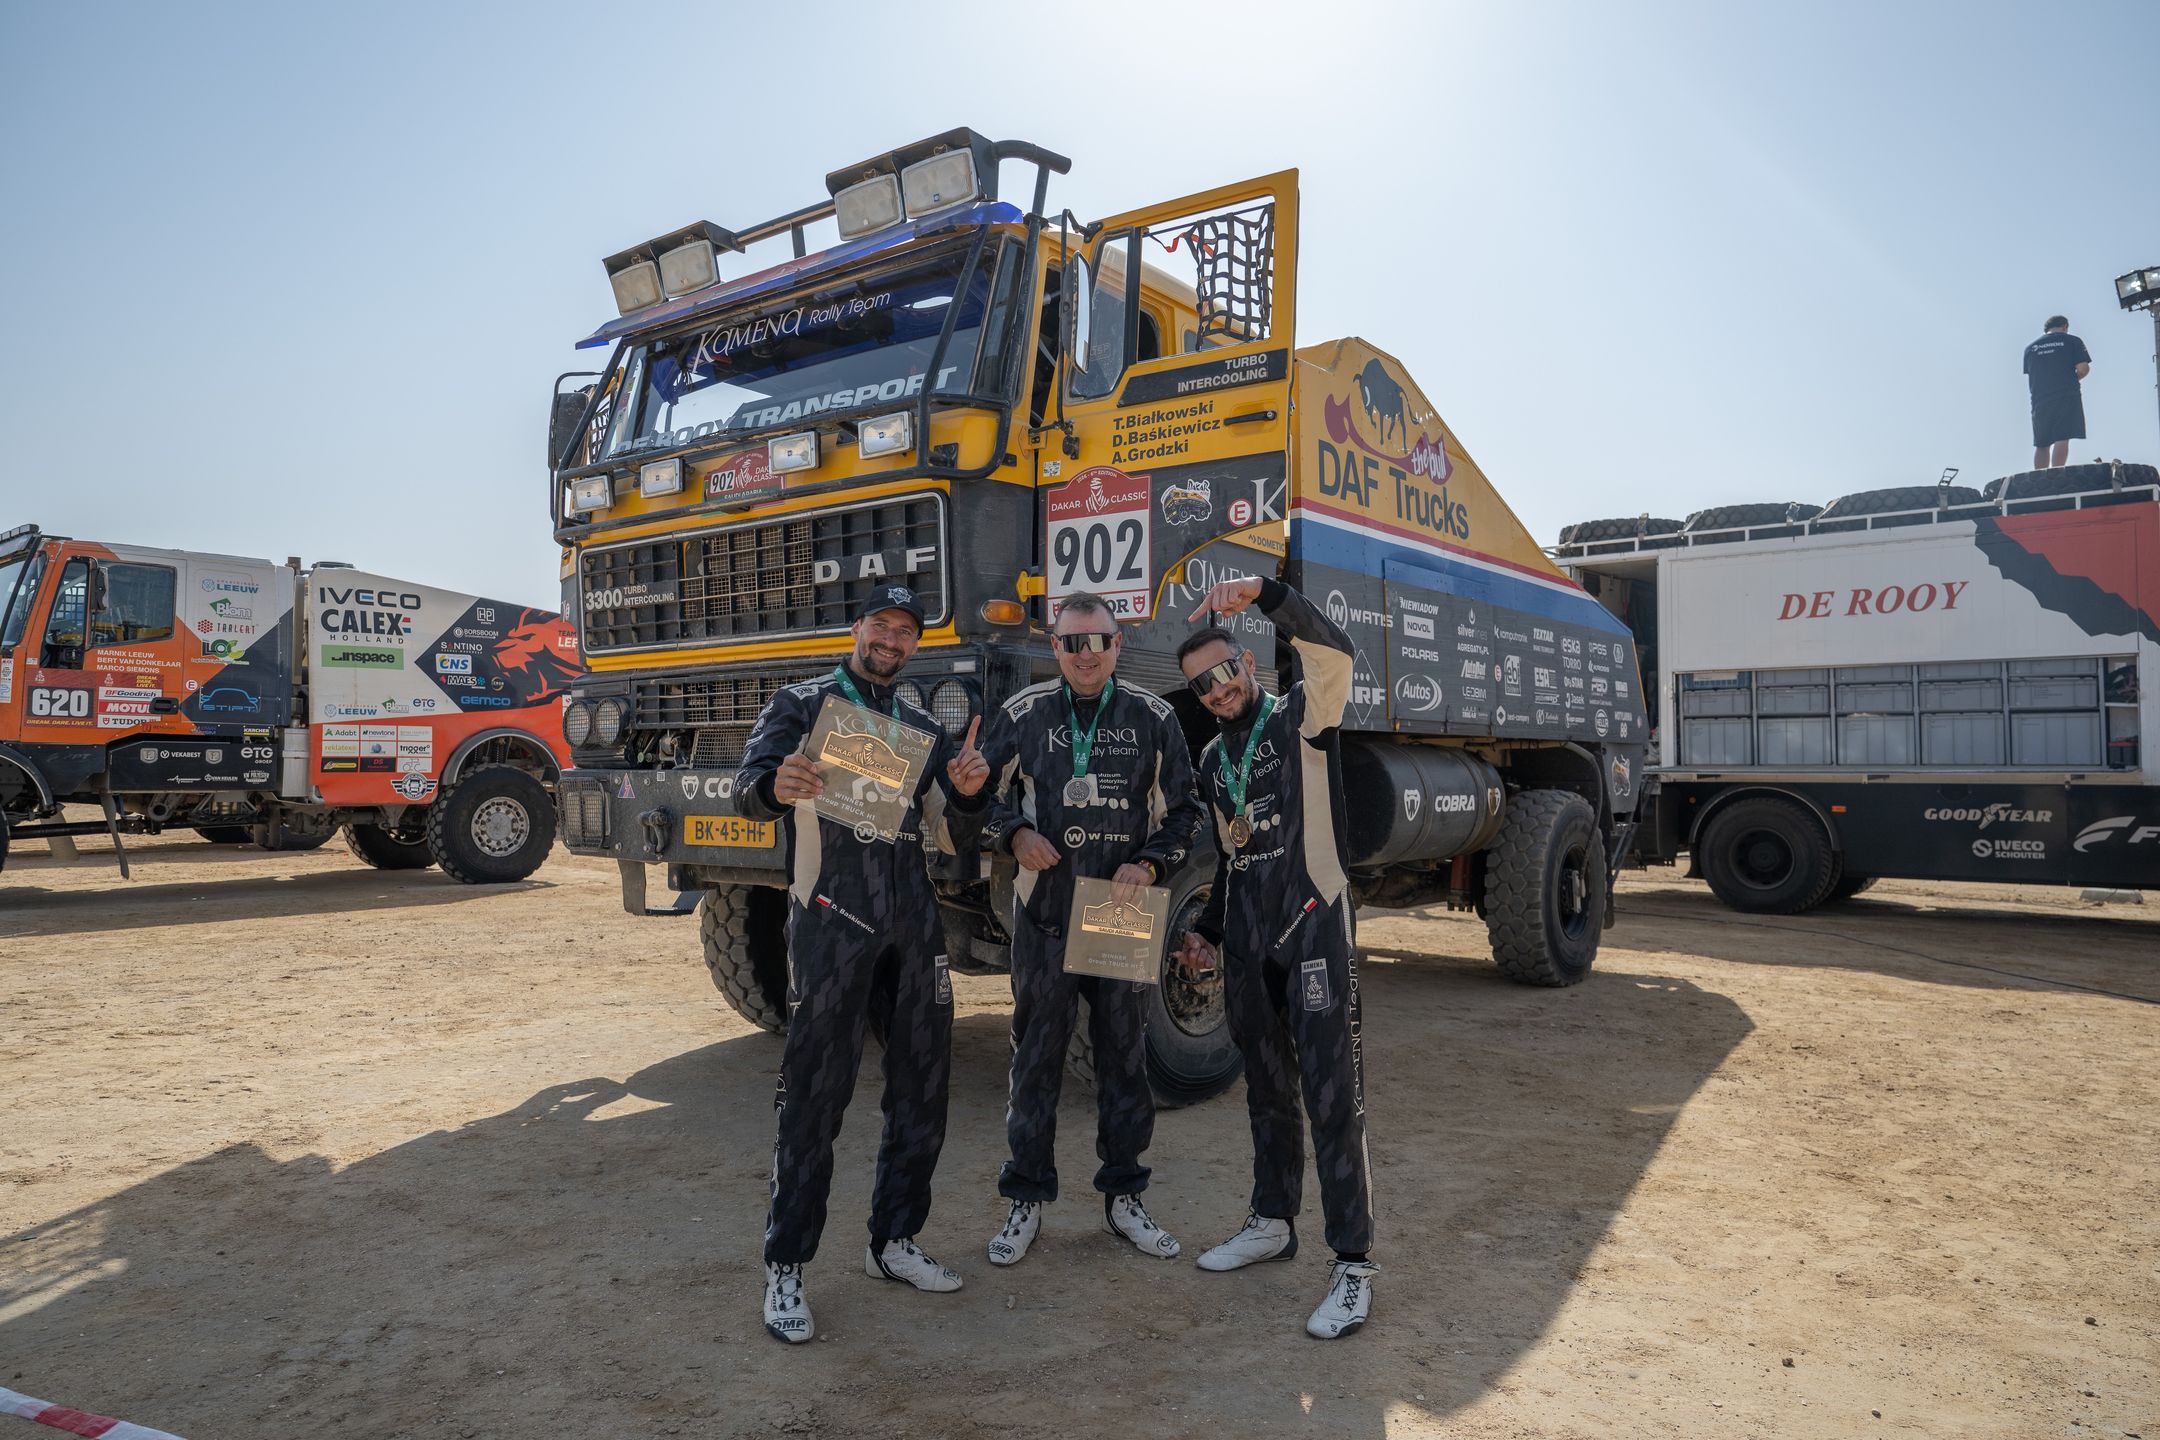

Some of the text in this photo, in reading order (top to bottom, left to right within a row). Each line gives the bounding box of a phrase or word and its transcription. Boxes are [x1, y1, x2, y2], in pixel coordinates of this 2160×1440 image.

[809, 304, 845, 326] Rally
[848, 292, 891, 315] Team
[1225, 354, 1267, 370] TURBO
[1178, 368, 1268, 392] INTERCOOLING
[741, 367, 957, 429] TRANSPORT
[1113, 400, 1214, 431] T.Białkowski
[1112, 418, 1220, 448] D.Baśkiewicz
[1111, 440, 1189, 464] A.Grodzki
[1411, 440, 1446, 479] the bull
[753, 473, 778, 482] CLASS
[756, 466, 770, 474] DAK
[1098, 470, 1118, 478] EDITION
[712, 472, 734, 492] 902
[1318, 439, 1469, 540] DAF Trucks
[1110, 491, 1147, 503] CLASSIC
[1052, 500, 1080, 512] DAKAR
[1054, 518, 1144, 586] 902
[1257, 536, 1285, 553] DOMETIC
[814, 546, 936, 584] DAF
[216, 584, 258, 594] LEEUW
[624, 584, 647, 594] TURBO
[320, 586, 422, 610] IVECO
[586, 588, 622, 610] 3300
[624, 592, 675, 606] INTERCOOLING
[1776, 580, 1970, 621] DE ROOY
[216, 602, 252, 618] Blom
[1350, 608, 1394, 628] WATIS
[320, 608, 405, 636] CALEX
[1240, 612, 1274, 636] Team
[1407, 622, 1431, 634] NOVOL
[330, 634, 404, 644] HOLLAND
[464, 628, 498, 636] BORSBOOM
[1534, 628, 1554, 642] TEXTAR
[98, 650, 126, 658] MARNIX
[440, 642, 482, 652] SANTINO
[1402, 646, 1440, 662] POLARIS
[1562, 638, 1580, 654] eska
[119, 658, 134, 666] VAN
[136, 660, 182, 668] DONKELAAR
[126, 666, 160, 674] SIEMONS
[440, 656, 468, 670] CNS
[448, 675, 478, 686] MAES
[105, 690, 156, 698] BFGoodrich
[1402, 681, 1431, 700] Autos
[32, 688, 89, 717] 620
[106, 703, 150, 714] MOTU
[1012, 701, 1028, 716] OMP
[1150, 700, 1166, 716] OMP
[338, 708, 378, 716] LEEUW
[828, 744, 852, 758] DAKAR
[1090, 746, 1139, 758] ally Team
[840, 760, 881, 781] SAUDI ARABIA
[874, 762, 902, 776] CLASSIC
[1253, 758, 1280, 779] Team
[817, 794, 838, 808] Group
[842, 802, 865, 816] TRUCK
[835, 792, 864, 808] WINNER
[1434, 794, 1476, 812] COBRA
[694, 820, 766, 842] BK-45-HF
[1995, 840, 2045, 851] IVECO
[1251, 846, 1285, 862] WATIS
[1995, 850, 2046, 860] SCHOUTEN
[1126, 922, 1150, 930] CLASSIC
[772, 1319, 806, 1330] OMP
